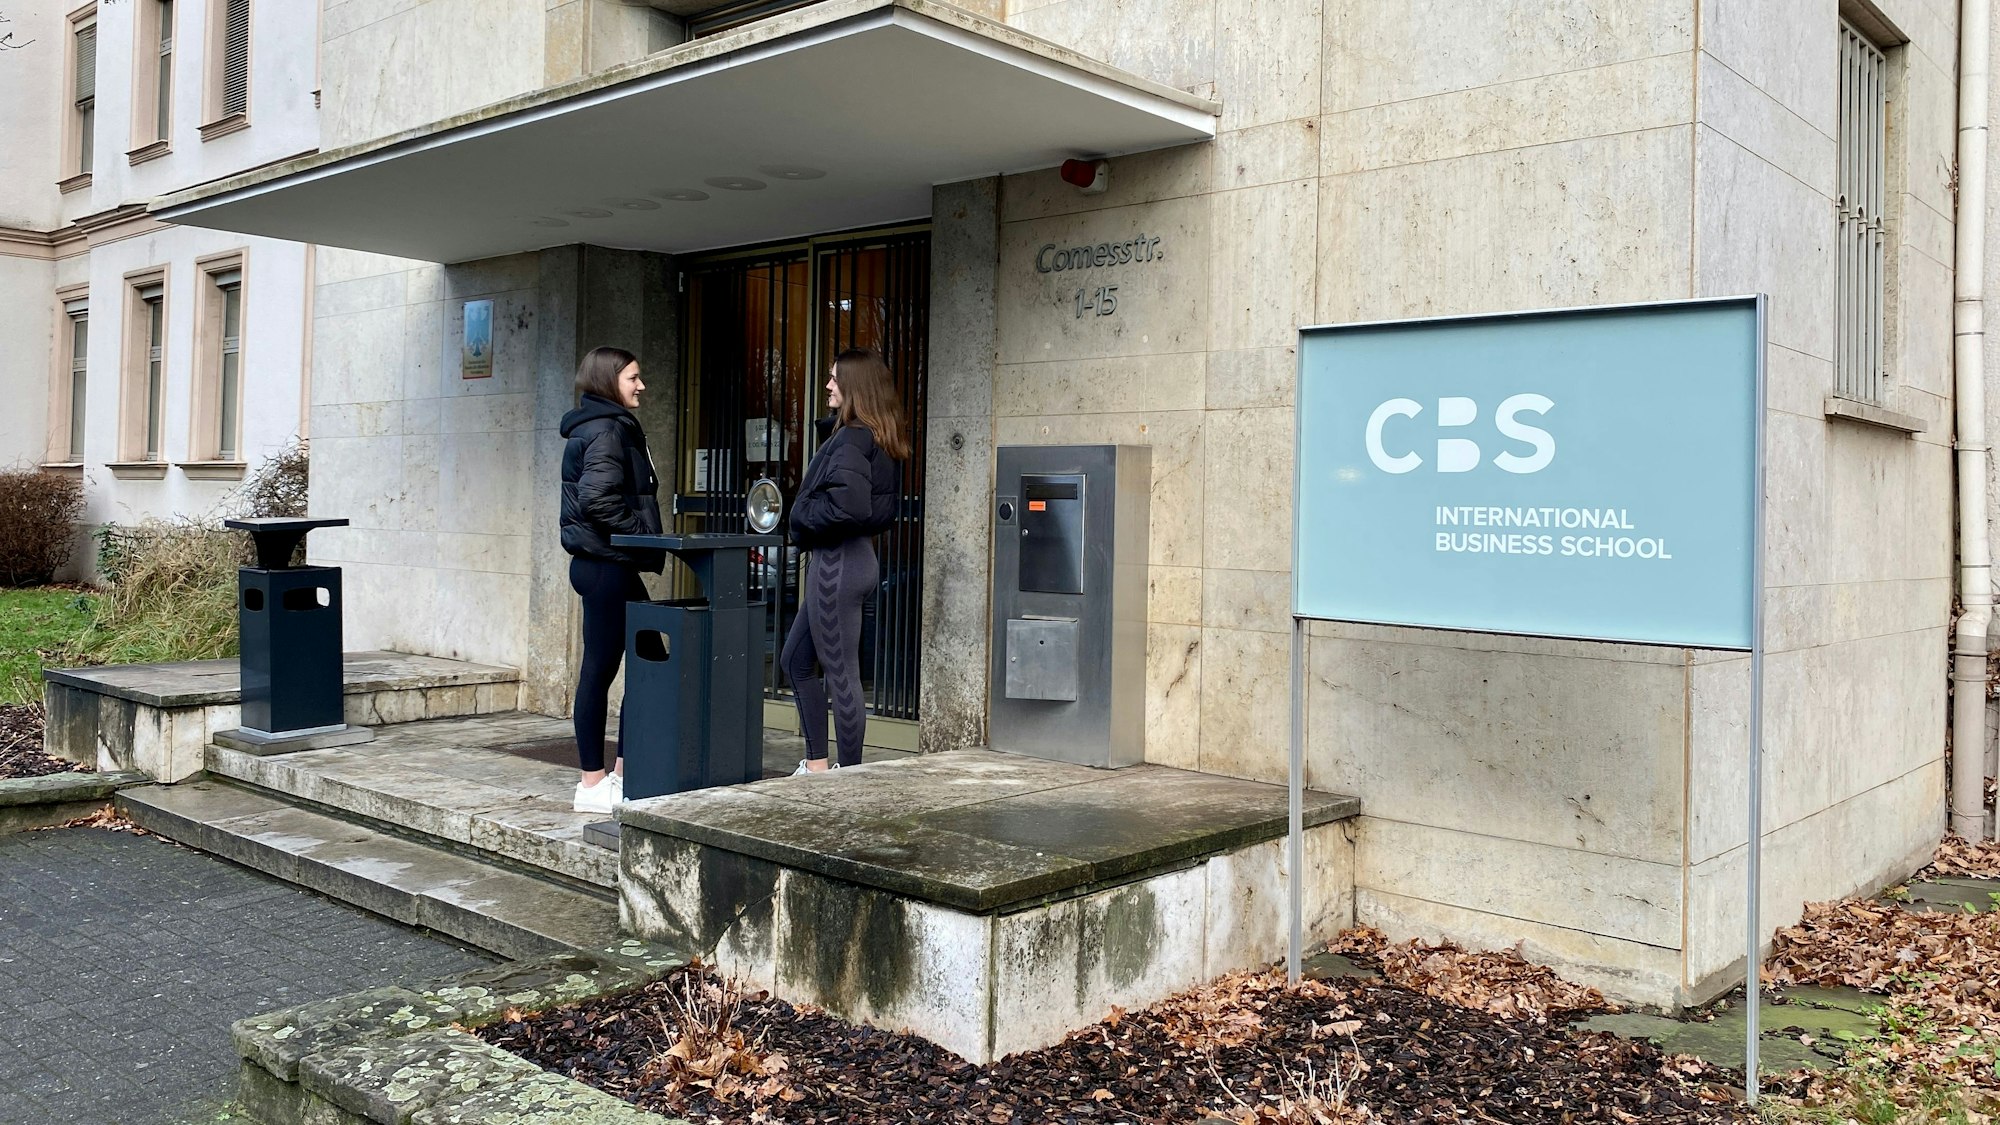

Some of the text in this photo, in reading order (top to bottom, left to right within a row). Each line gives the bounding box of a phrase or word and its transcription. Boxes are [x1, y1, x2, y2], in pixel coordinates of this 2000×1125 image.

[1036, 233, 1163, 273] Comesstr.
[1074, 285, 1118, 319] 1-15
[1365, 393, 1556, 474] CBS
[1435, 506, 1635, 529] INTERNATIONAL
[1435, 533, 1672, 559] BUSINESS SCHOOL
